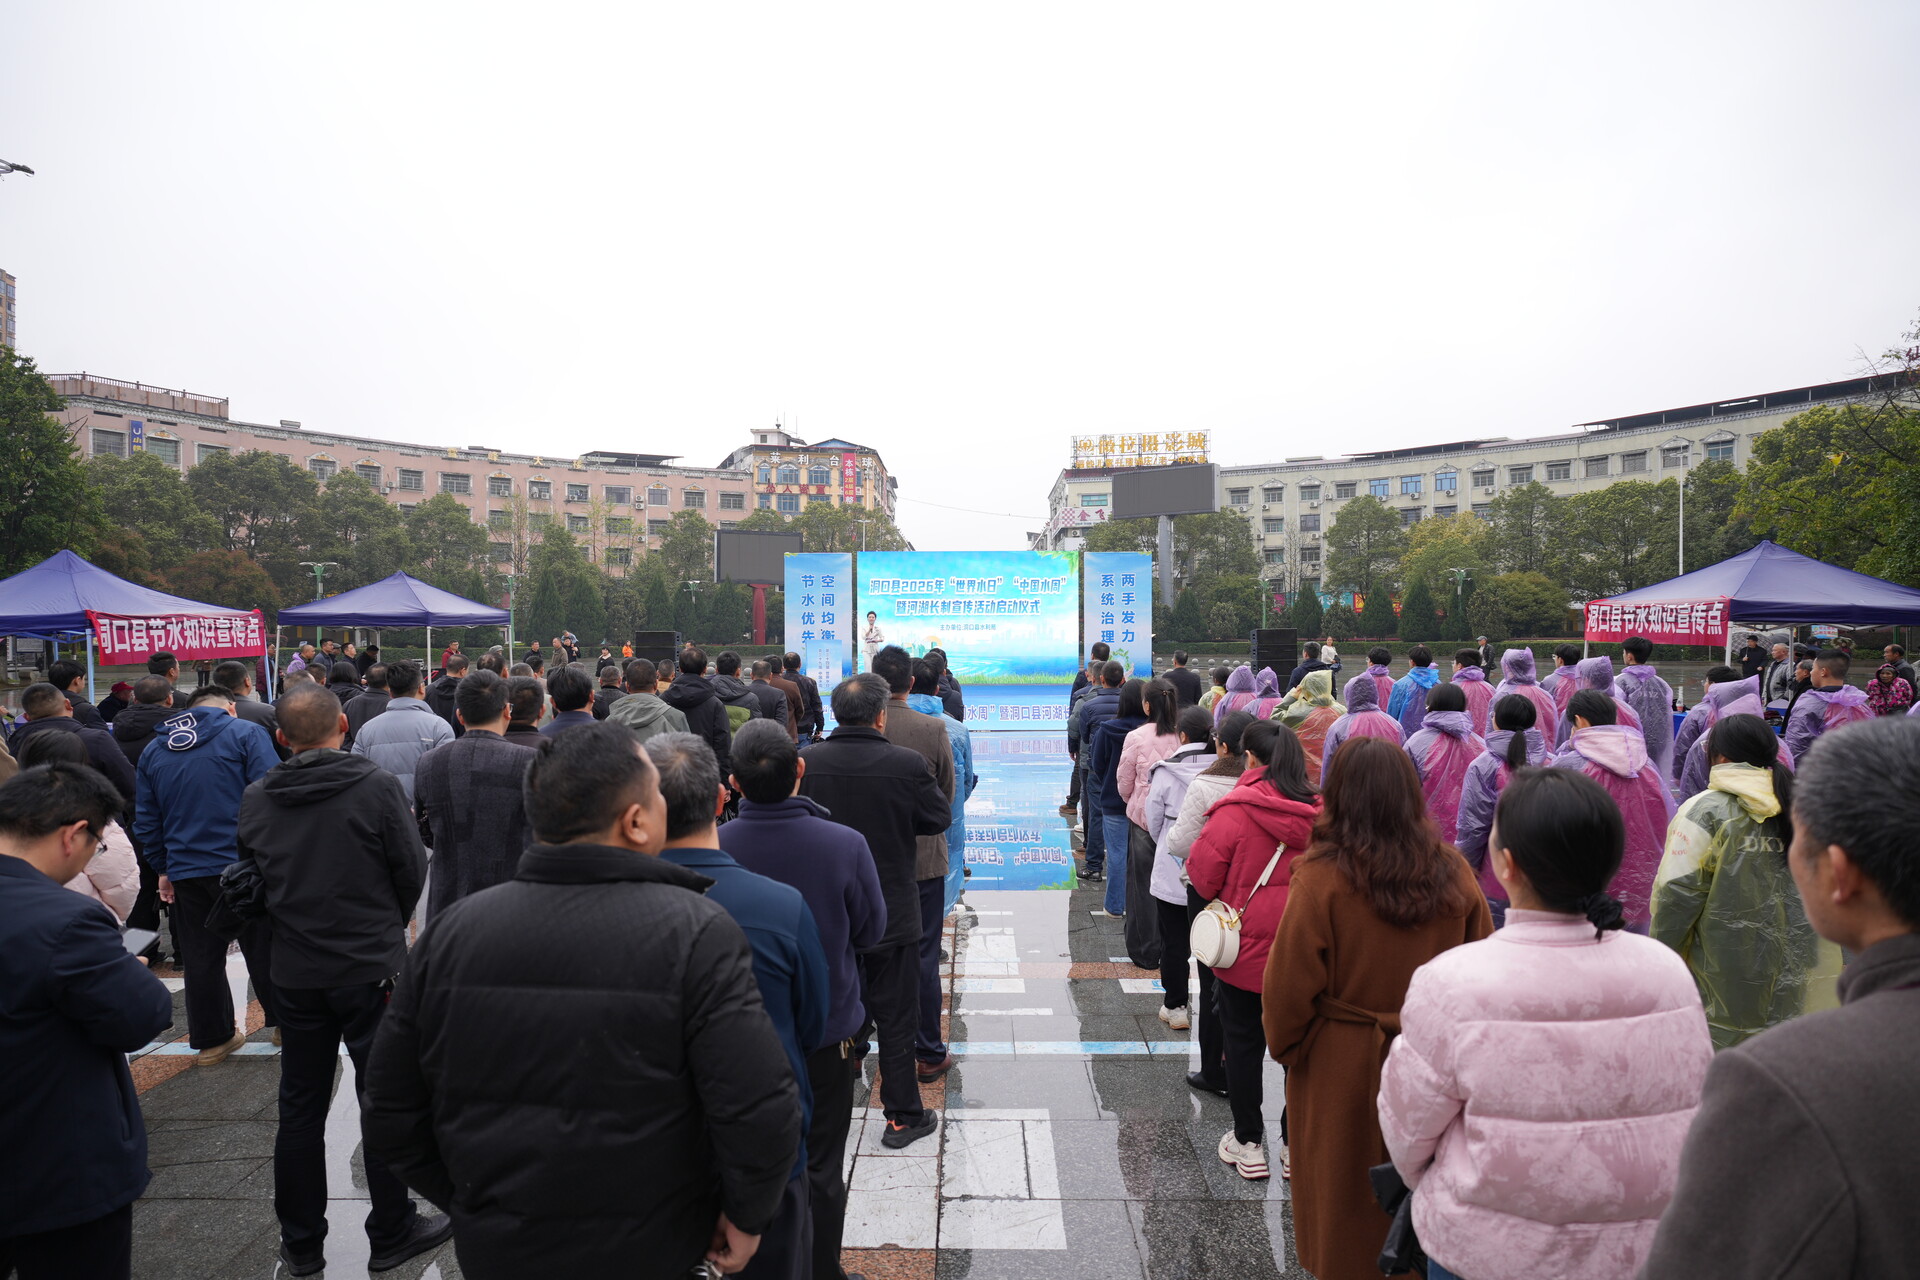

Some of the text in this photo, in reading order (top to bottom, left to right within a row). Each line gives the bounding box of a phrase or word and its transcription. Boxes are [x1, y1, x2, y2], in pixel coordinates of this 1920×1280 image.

[801, 574, 815, 643] 节水优先
[821, 574, 835, 640] 空间均衡
[896, 599, 1041, 615] 暨河湖长制宣传活动启动仪式
[1101, 574, 1115, 643] 系统治理
[1121, 573, 1136, 643] 两手发力
[1586, 602, 1724, 635] 洞口县节水知识宣传点
